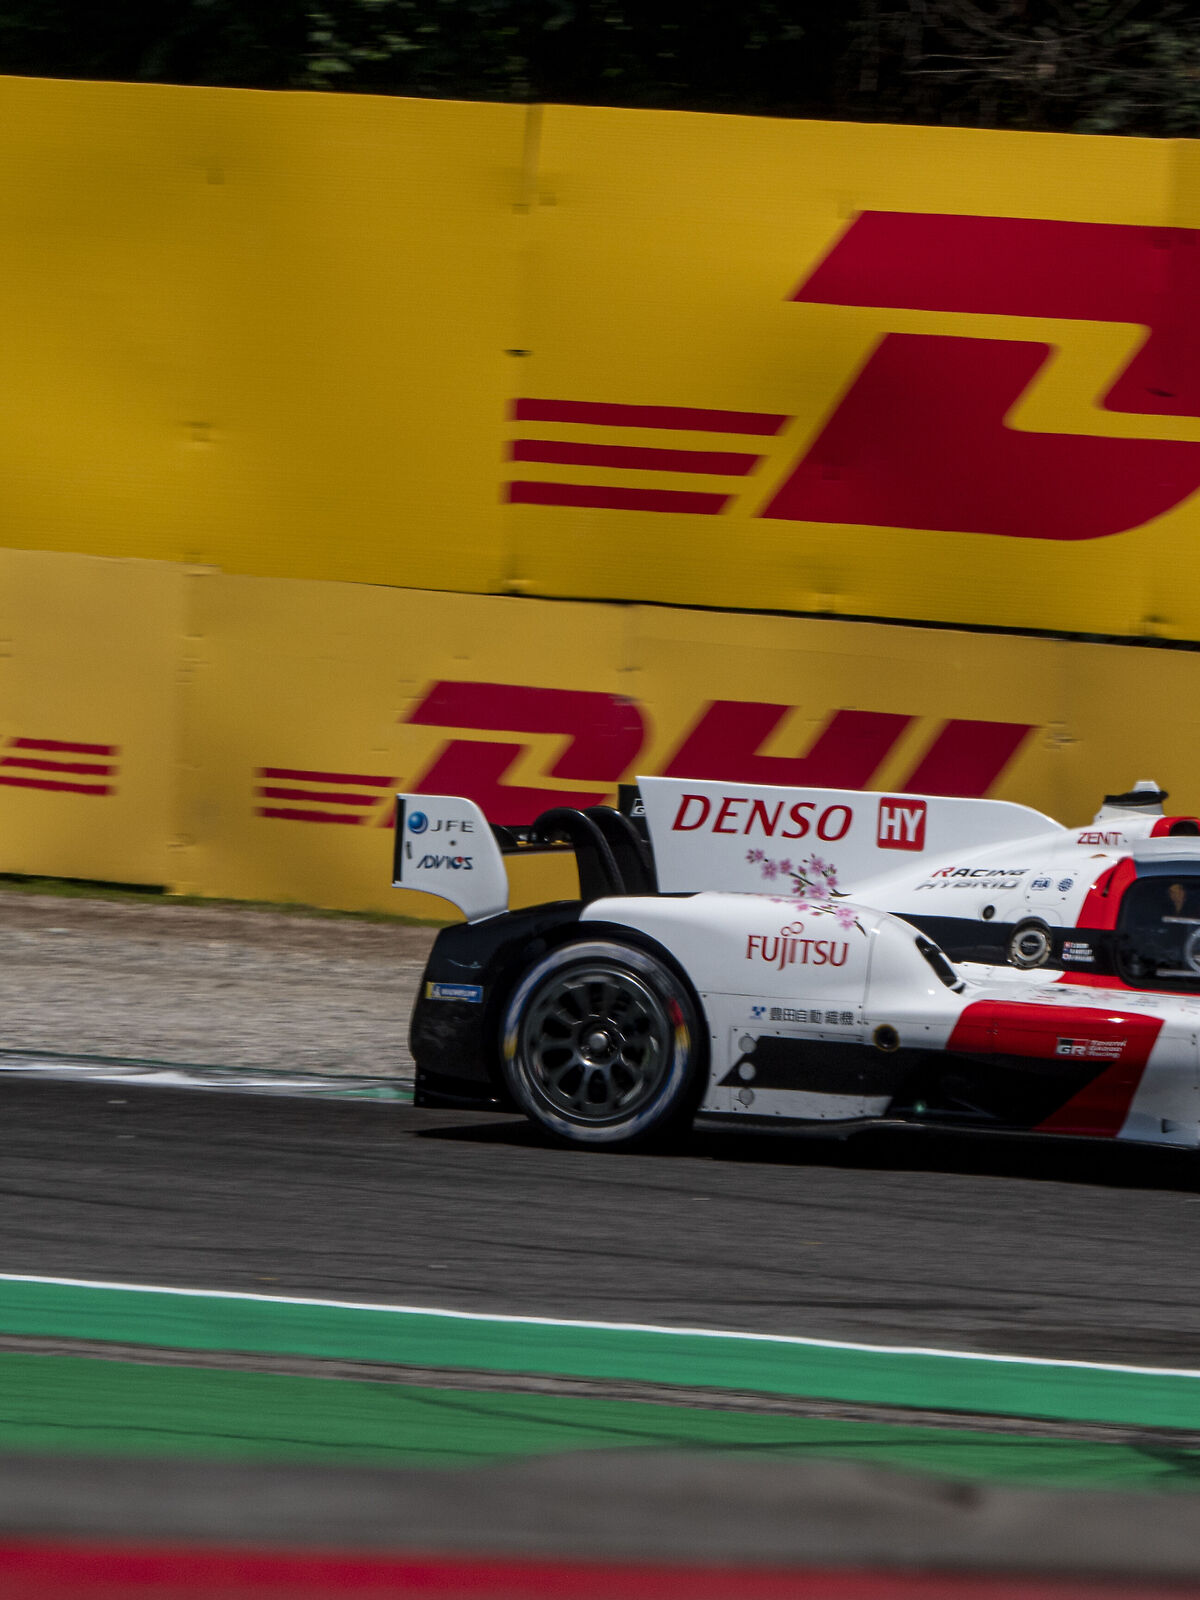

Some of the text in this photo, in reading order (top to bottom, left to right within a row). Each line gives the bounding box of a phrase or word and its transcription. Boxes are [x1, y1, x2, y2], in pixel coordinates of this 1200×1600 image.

[672, 794, 853, 841] DENSO
[880, 806, 924, 842] HY
[430, 820, 474, 833] JFE
[1077, 831, 1122, 846] ZENT
[931, 867, 1031, 877] RACING
[745, 933, 850, 971] FUJITSU
[1057, 1045, 1086, 1055] GR
